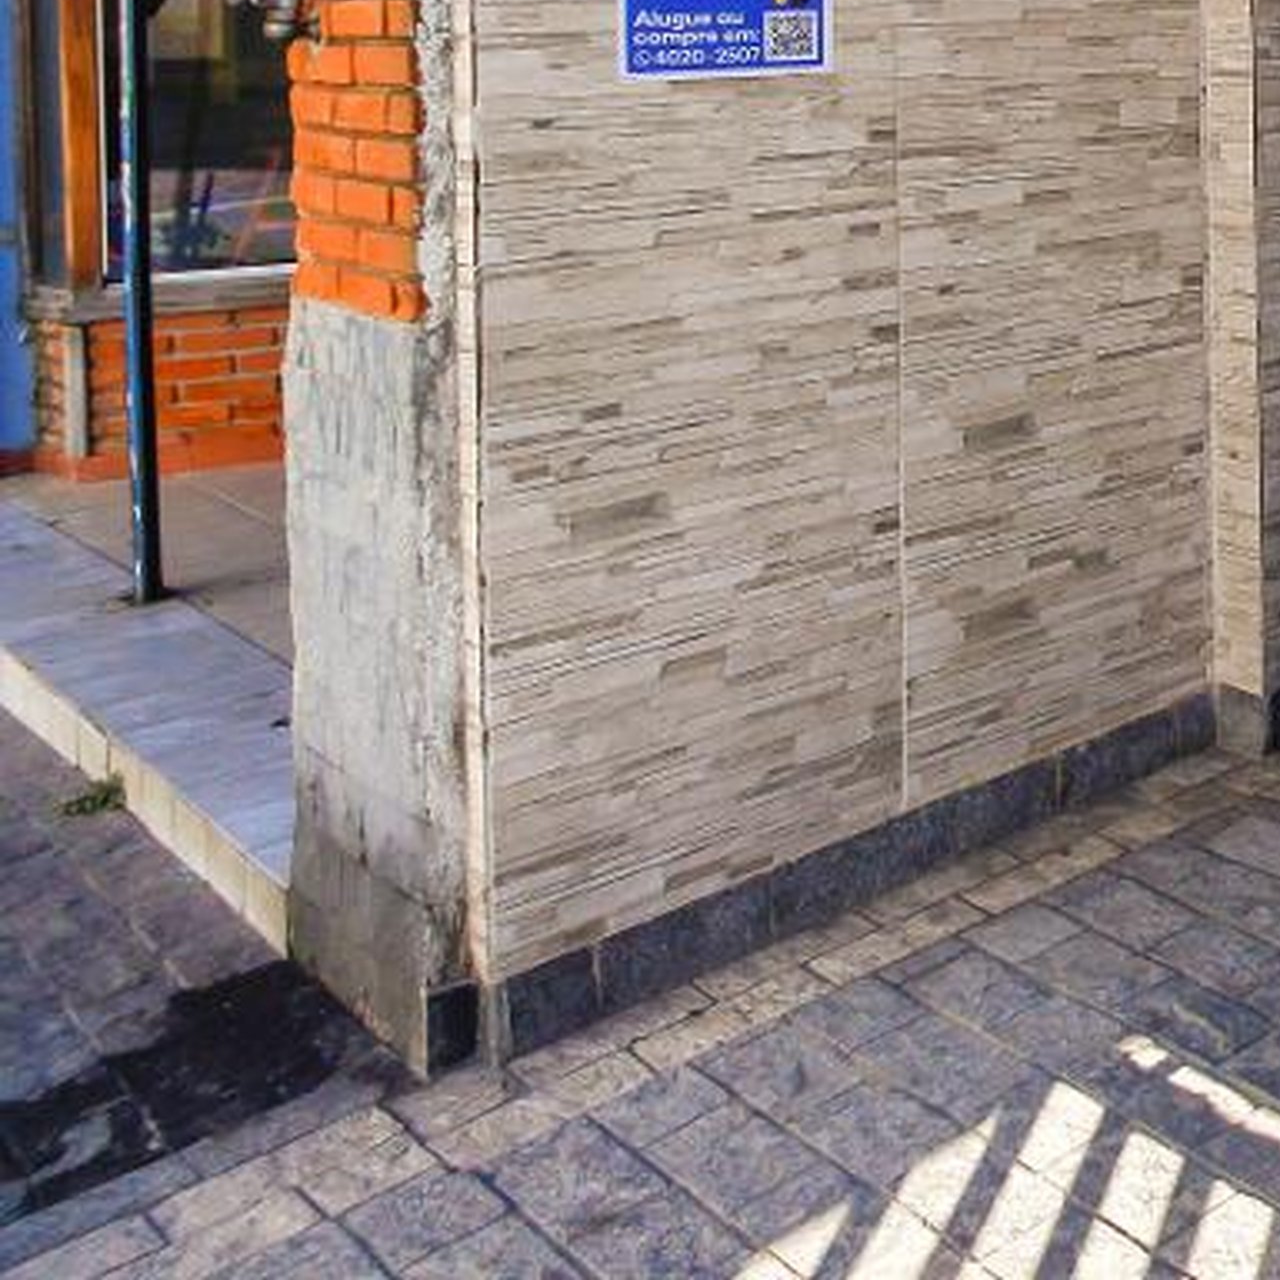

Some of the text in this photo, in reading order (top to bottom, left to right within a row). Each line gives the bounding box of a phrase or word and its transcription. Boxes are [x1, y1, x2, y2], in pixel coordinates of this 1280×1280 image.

[633, 10, 745, 31] Alugue ou
[632, 30, 718, 47] compre
